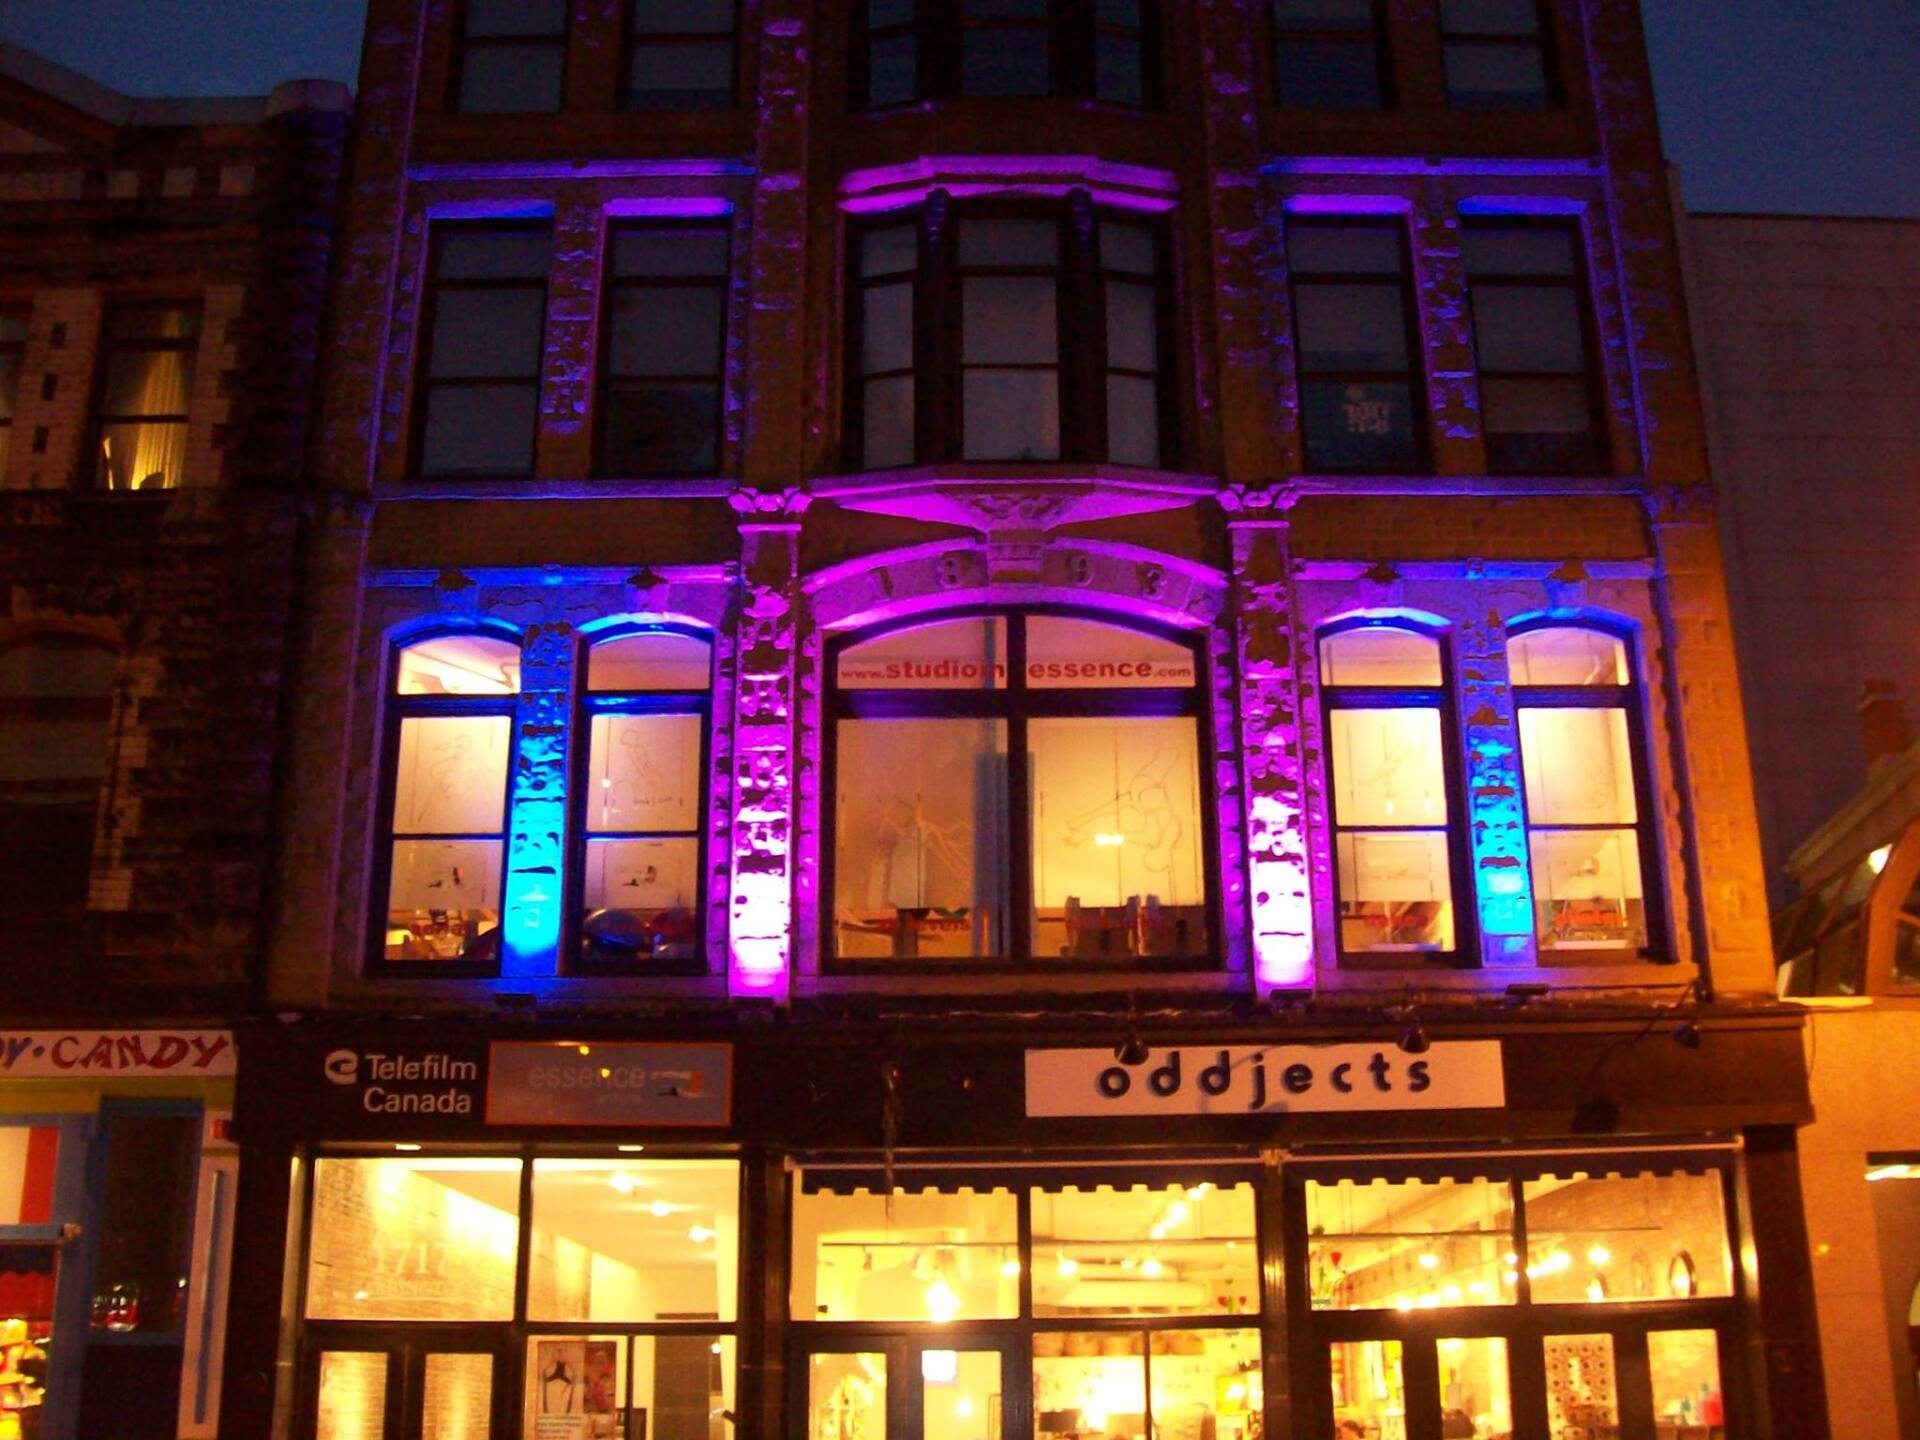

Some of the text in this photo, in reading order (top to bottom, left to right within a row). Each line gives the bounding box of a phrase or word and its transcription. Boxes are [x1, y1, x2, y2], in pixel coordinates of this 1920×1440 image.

[51, 1034, 229, 1070] CANDY
[366, 1054, 477, 1081] Telefilm
[1098, 1050, 1432, 1111] oddjects
[363, 1086, 472, 1113] Canada
